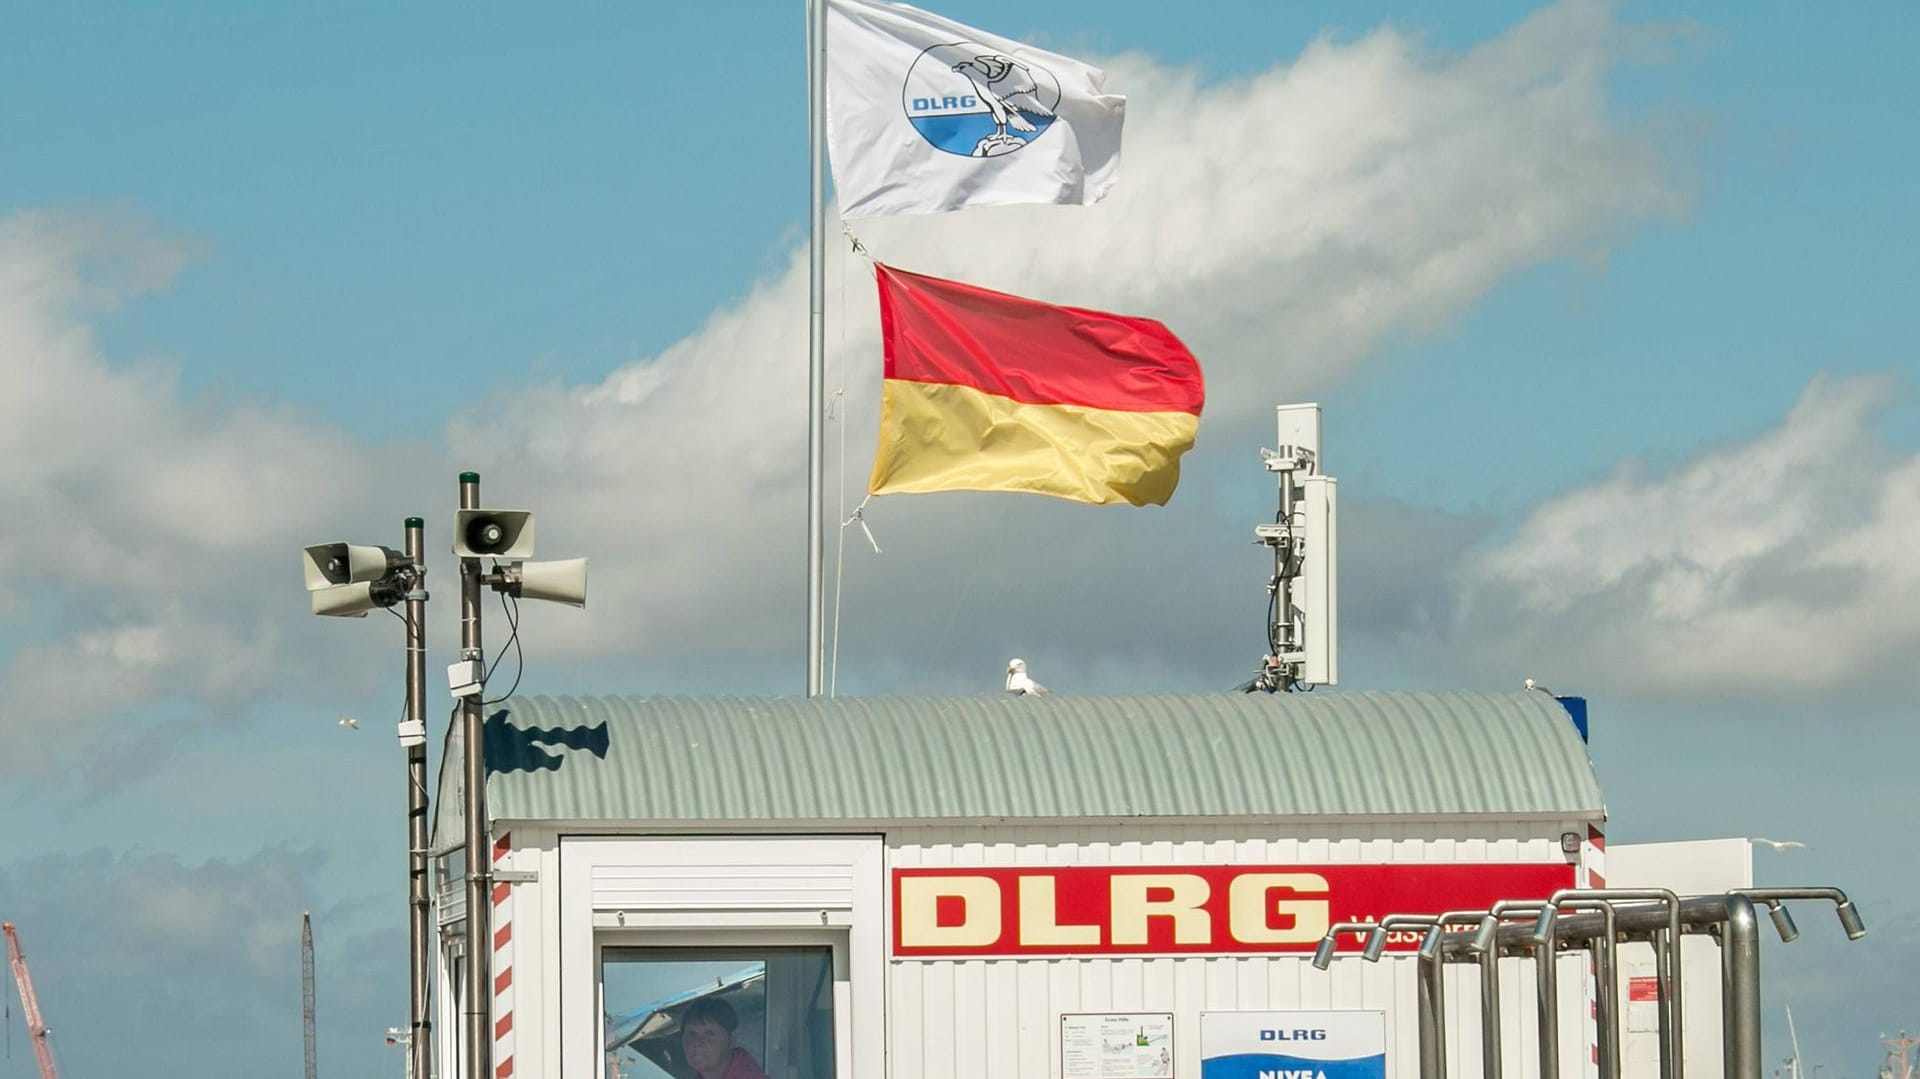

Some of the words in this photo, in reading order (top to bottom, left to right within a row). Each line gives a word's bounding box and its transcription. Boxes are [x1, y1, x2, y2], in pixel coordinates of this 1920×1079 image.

[913, 95, 976, 110] DLRG
[900, 873, 1330, 947] DLRG
[1260, 1029, 1326, 1041] DLRG
[1259, 1070, 1328, 1079] NIVEA
